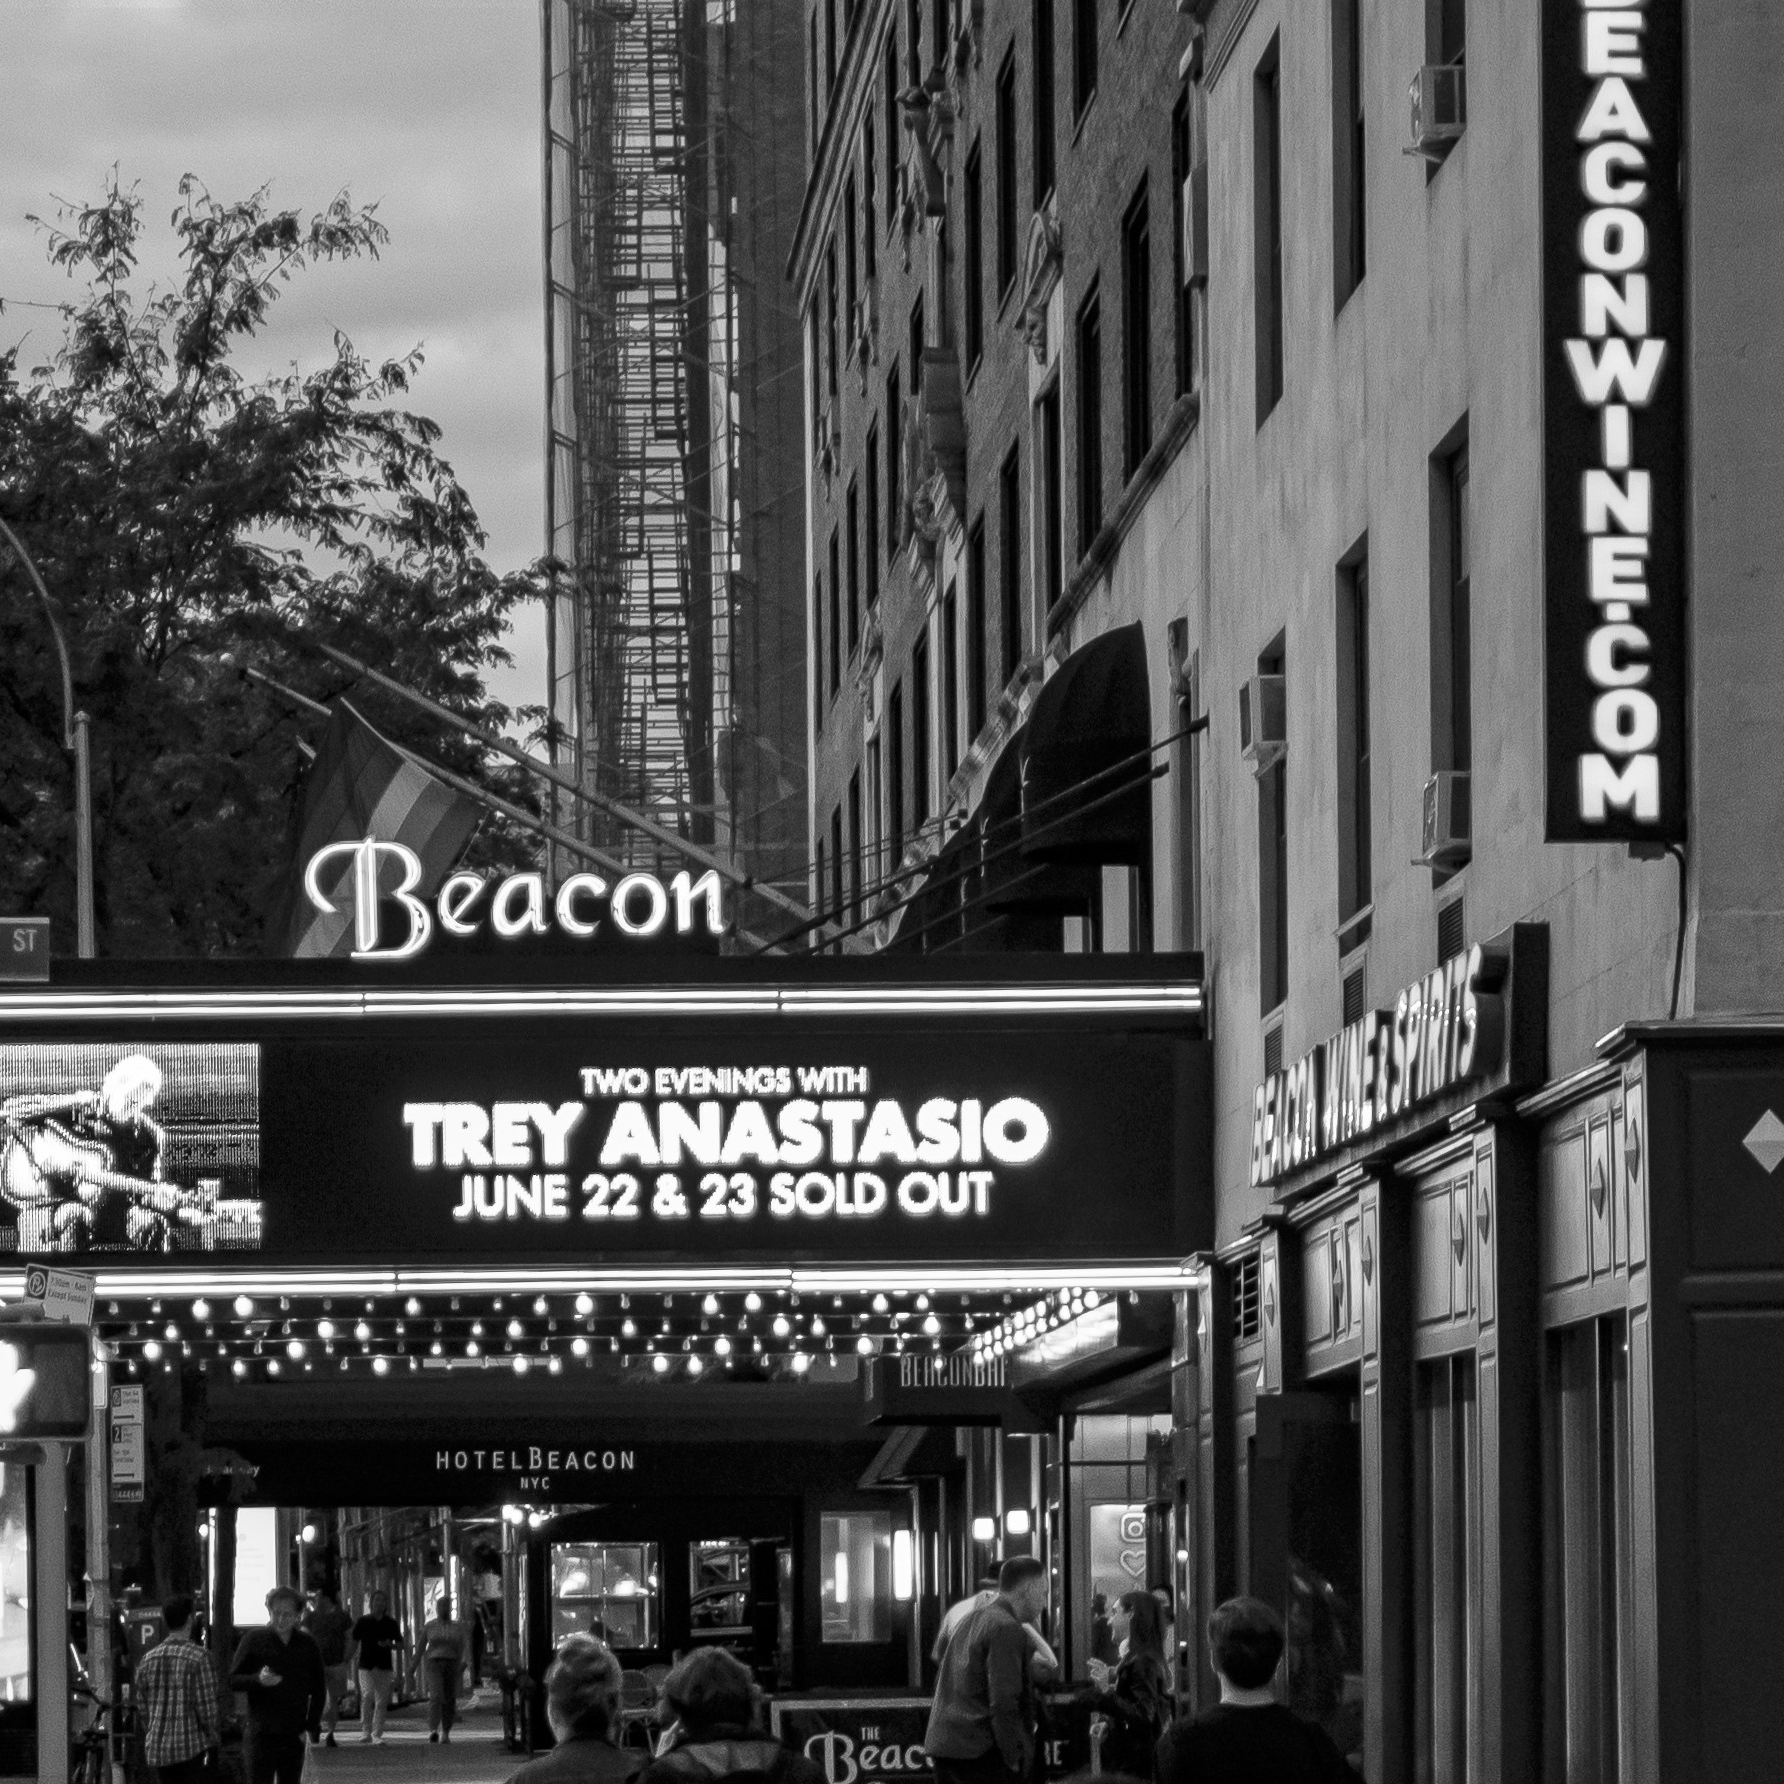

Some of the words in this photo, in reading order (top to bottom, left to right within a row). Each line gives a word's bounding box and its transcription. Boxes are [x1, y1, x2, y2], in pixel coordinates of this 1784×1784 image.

[1564, 0, 1666, 820] EACONWINE.COM
[304, 835, 725, 961] Beacon
[13, 928, 38, 952] ST
[579, 1065, 653, 1098] TWO
[656, 1065, 792, 1098] EVENINGS
[796, 1065, 870, 1098] WITH
[1251, 1046, 1316, 1187] BEACON
[1390, 942, 1483, 1114] SPIRITS
[402, 1100, 586, 1169] TREY
[598, 1096, 1052, 1169] ANASTASIO
[452, 1171, 571, 1222] JUNE
[579, 1171, 644, 1222] 22
[651, 1172, 690, 1222] &
[696, 1171, 759, 1222] 23
[766, 1171, 888, 1222] SOLD
[895, 1171, 996, 1222] OUT
[520, 1476, 550, 1490] NYC
[141, 1624, 154, 1645] P
[861, 1726, 881, 1741] THE
